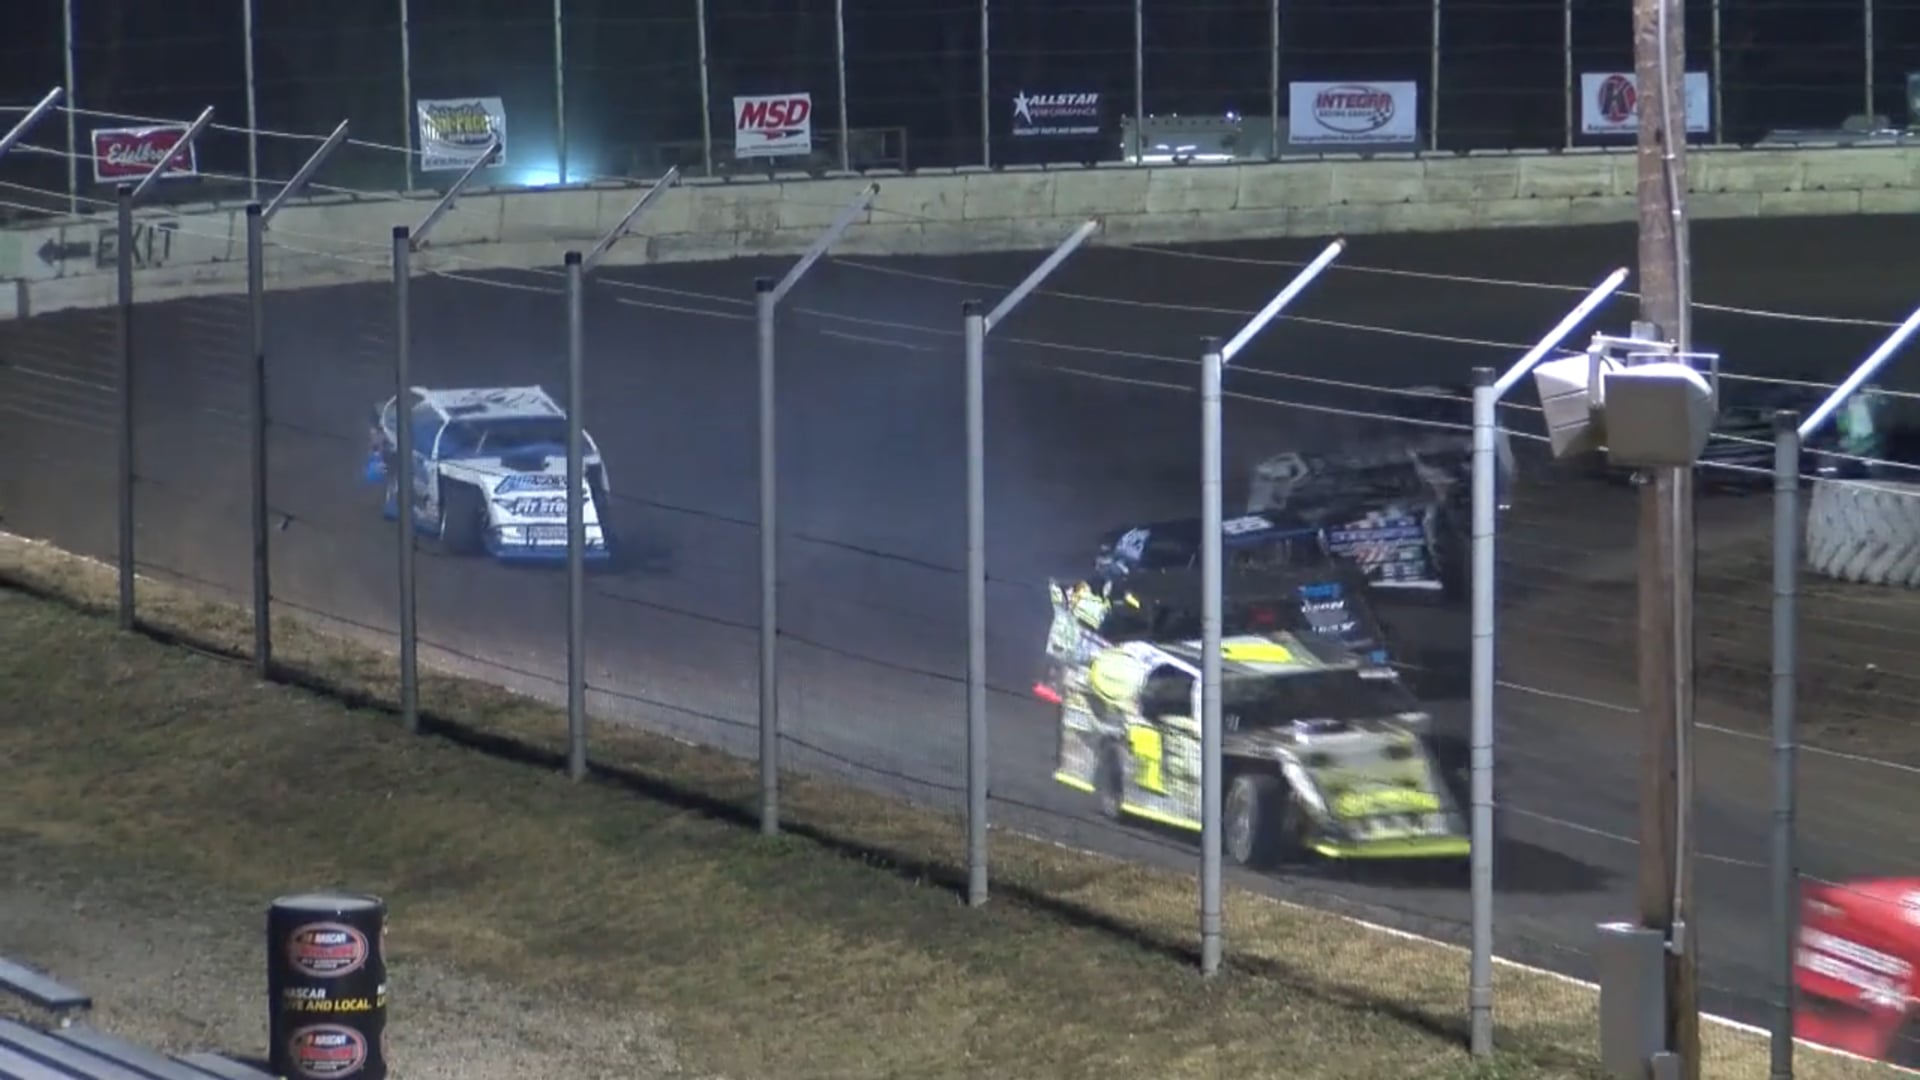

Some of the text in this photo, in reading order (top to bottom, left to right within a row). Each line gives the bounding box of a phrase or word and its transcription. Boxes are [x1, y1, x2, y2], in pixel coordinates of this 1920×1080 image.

[1029, 93, 1098, 106] ALLSTAR
[1317, 92, 1392, 112] INTEGRA
[738, 98, 810, 129] MSD
[107, 140, 184, 166] Edelbro
[305, 1000, 333, 1011] AND
